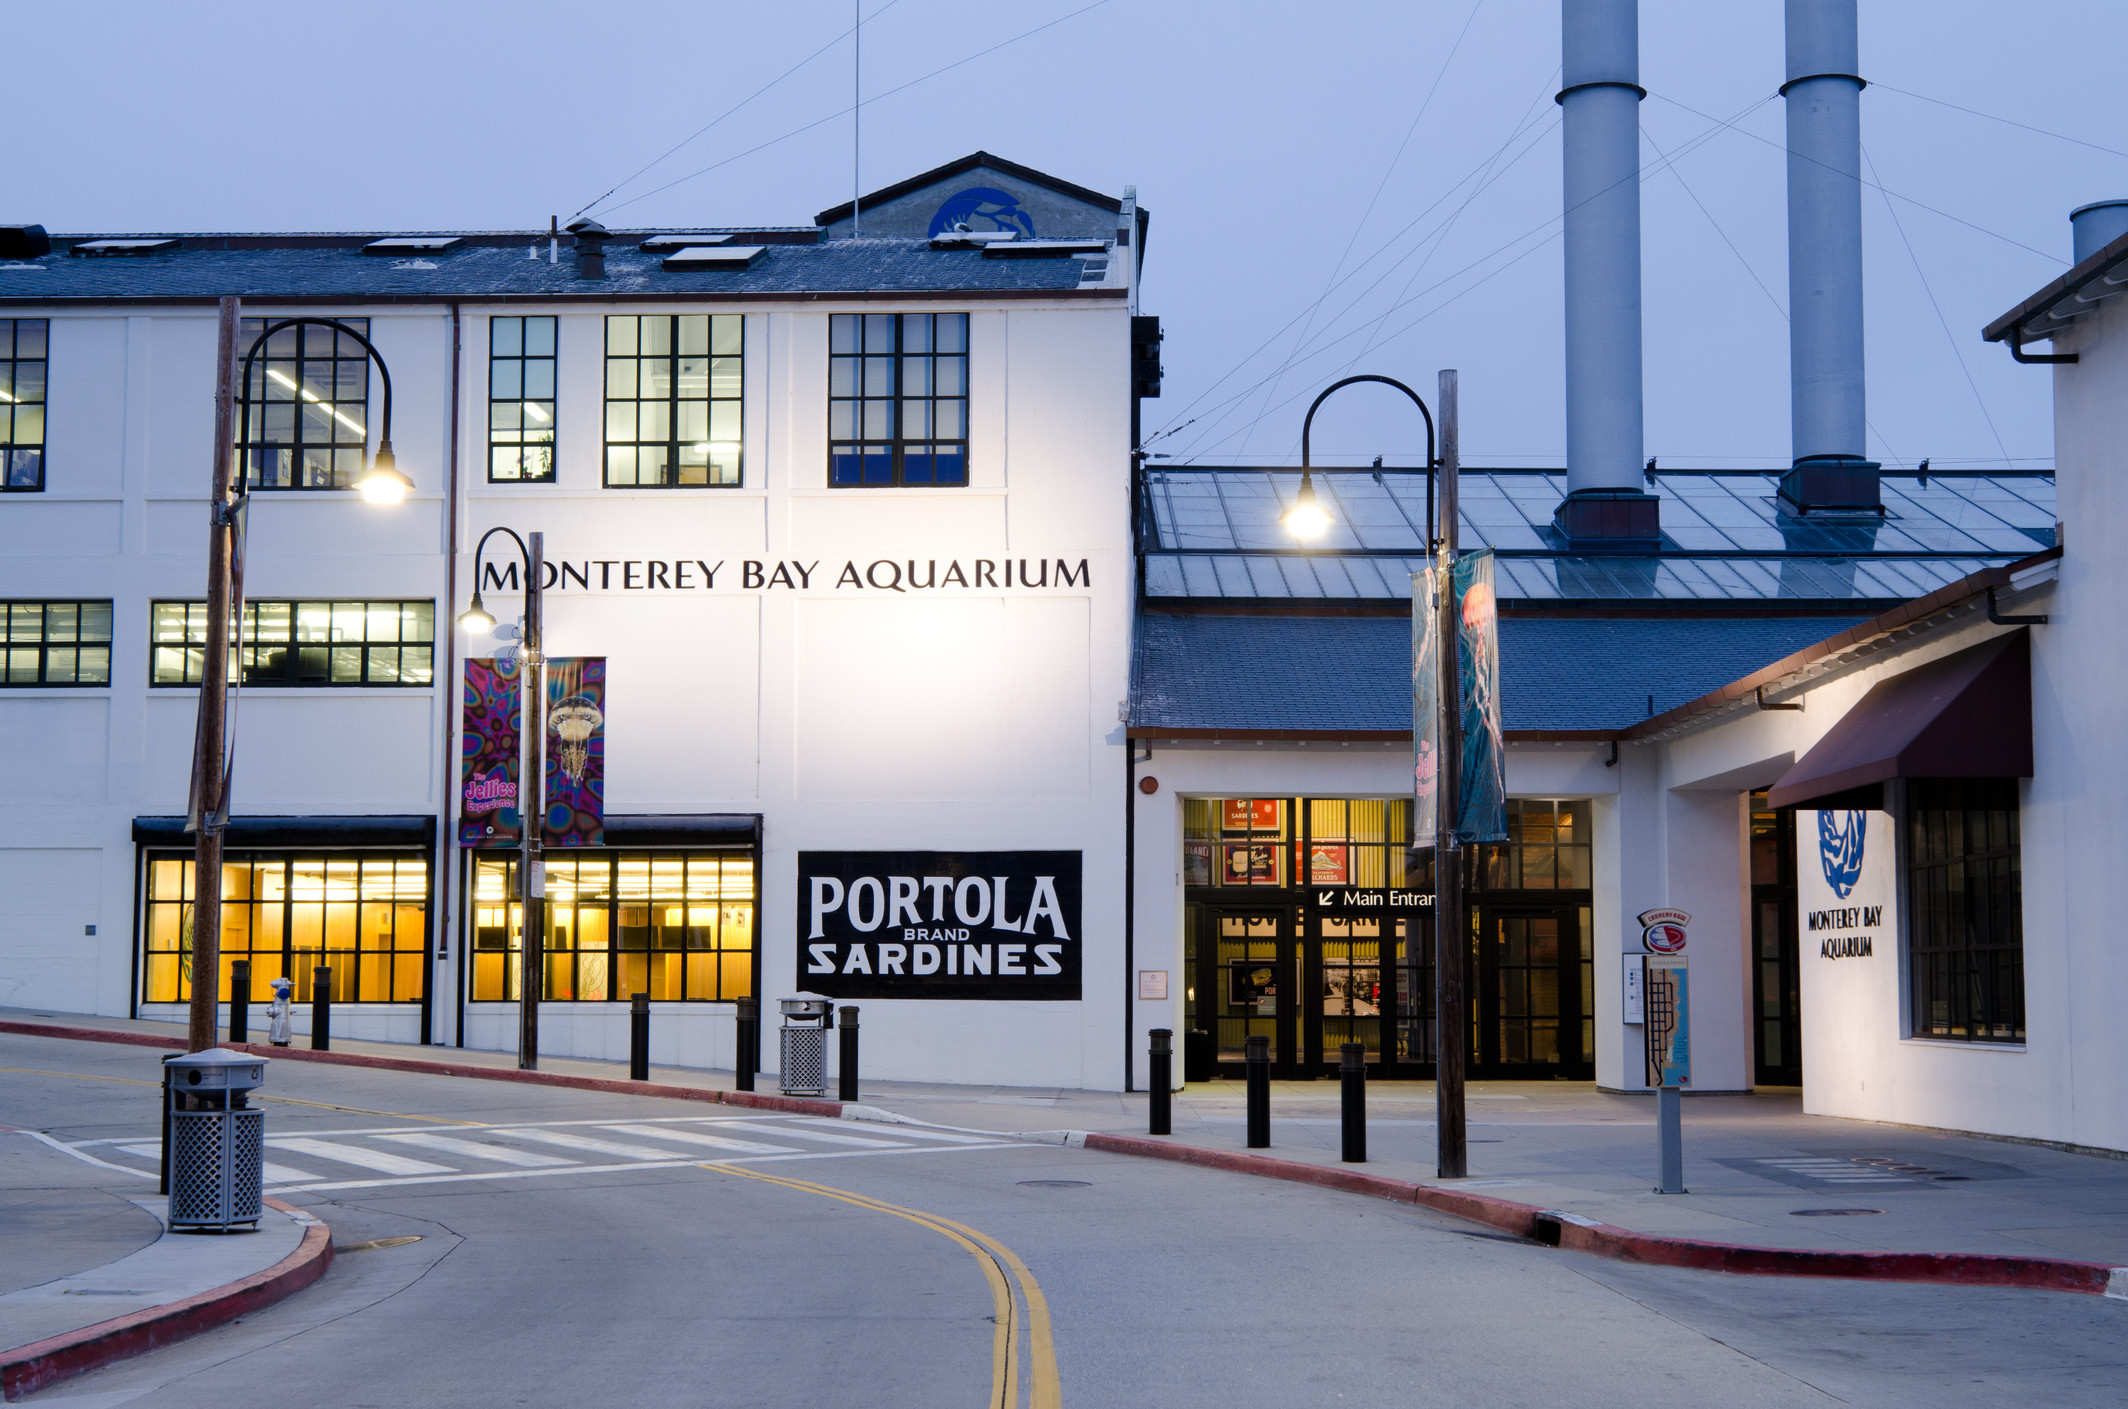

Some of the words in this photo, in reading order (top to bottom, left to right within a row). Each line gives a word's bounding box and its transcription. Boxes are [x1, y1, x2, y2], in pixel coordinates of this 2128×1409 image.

[742, 560, 819, 590] BAY
[836, 558, 1091, 593] AQUARIUM
[473, 773, 486, 781] The
[465, 779, 516, 800] Jellies
[466, 798, 515, 813] Experience
[808, 876, 1071, 941] PORTOLA
[1344, 890, 1383, 906] Main
[1389, 890, 1436, 906] Entran
[1647, 912, 1672, 922] CANNERY
[1673, 912, 1687, 922] ROW
[1808, 907, 1859, 931] MONTEREY
[1863, 905, 1882, 928] BAY
[904, 928, 970, 942] BRAND
[1820, 936, 1873, 960] AQUARIUM
[808, 943, 1062, 975] SARDINES
